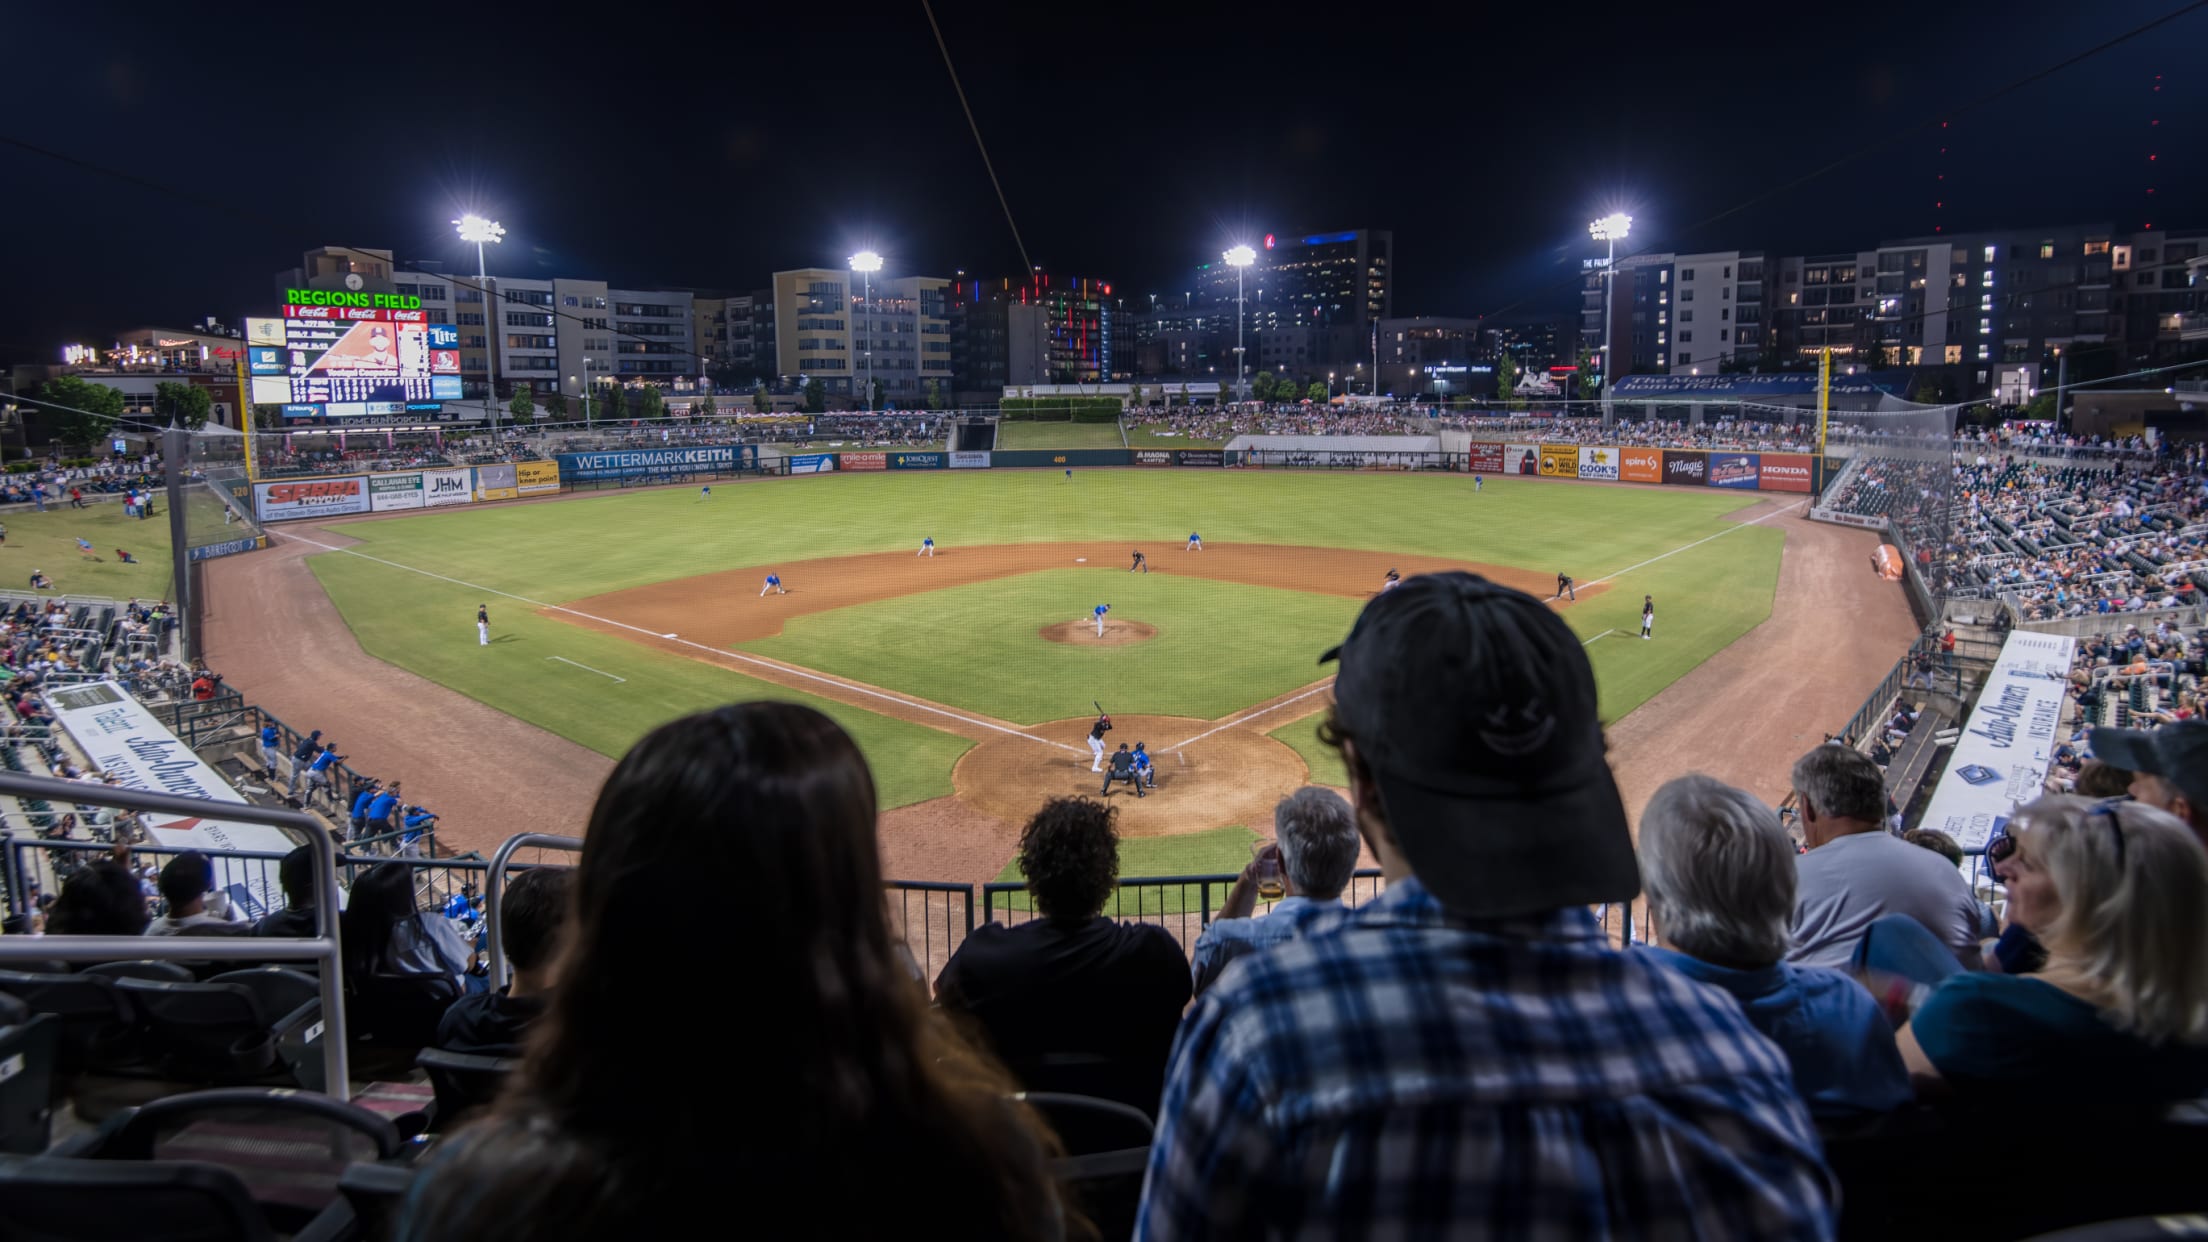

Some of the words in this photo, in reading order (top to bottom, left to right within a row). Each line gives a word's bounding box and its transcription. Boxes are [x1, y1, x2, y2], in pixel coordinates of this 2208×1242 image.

[287, 289, 370, 306] REGIONS
[374, 294, 420, 309] FIELD
[430, 328, 457, 345] Lite
[342, 417, 368, 425] HOME
[371, 416, 388, 424] RUN
[391, 416, 420, 424] PORCH
[576, 452, 684, 470] WETTERMARK
[685, 449, 732, 462] KEITH
[1625, 457, 1645, 466] spire
[65, 466, 117, 480] PARTY
[1580, 464, 1617, 474] COOK'S
[1669, 461, 1704, 474] Magic
[1762, 466, 1808, 475] HONDA
[432, 477, 463, 492] JHM
[539, 475, 557, 484] pain?
[233, 486, 248, 497] 320
[266, 480, 360, 504] SERRA
[298, 494, 346, 505] TOYOTA
[1969, 684, 2030, 748] Auto-Owners
[2028, 699, 2058, 741] INSURANCE
